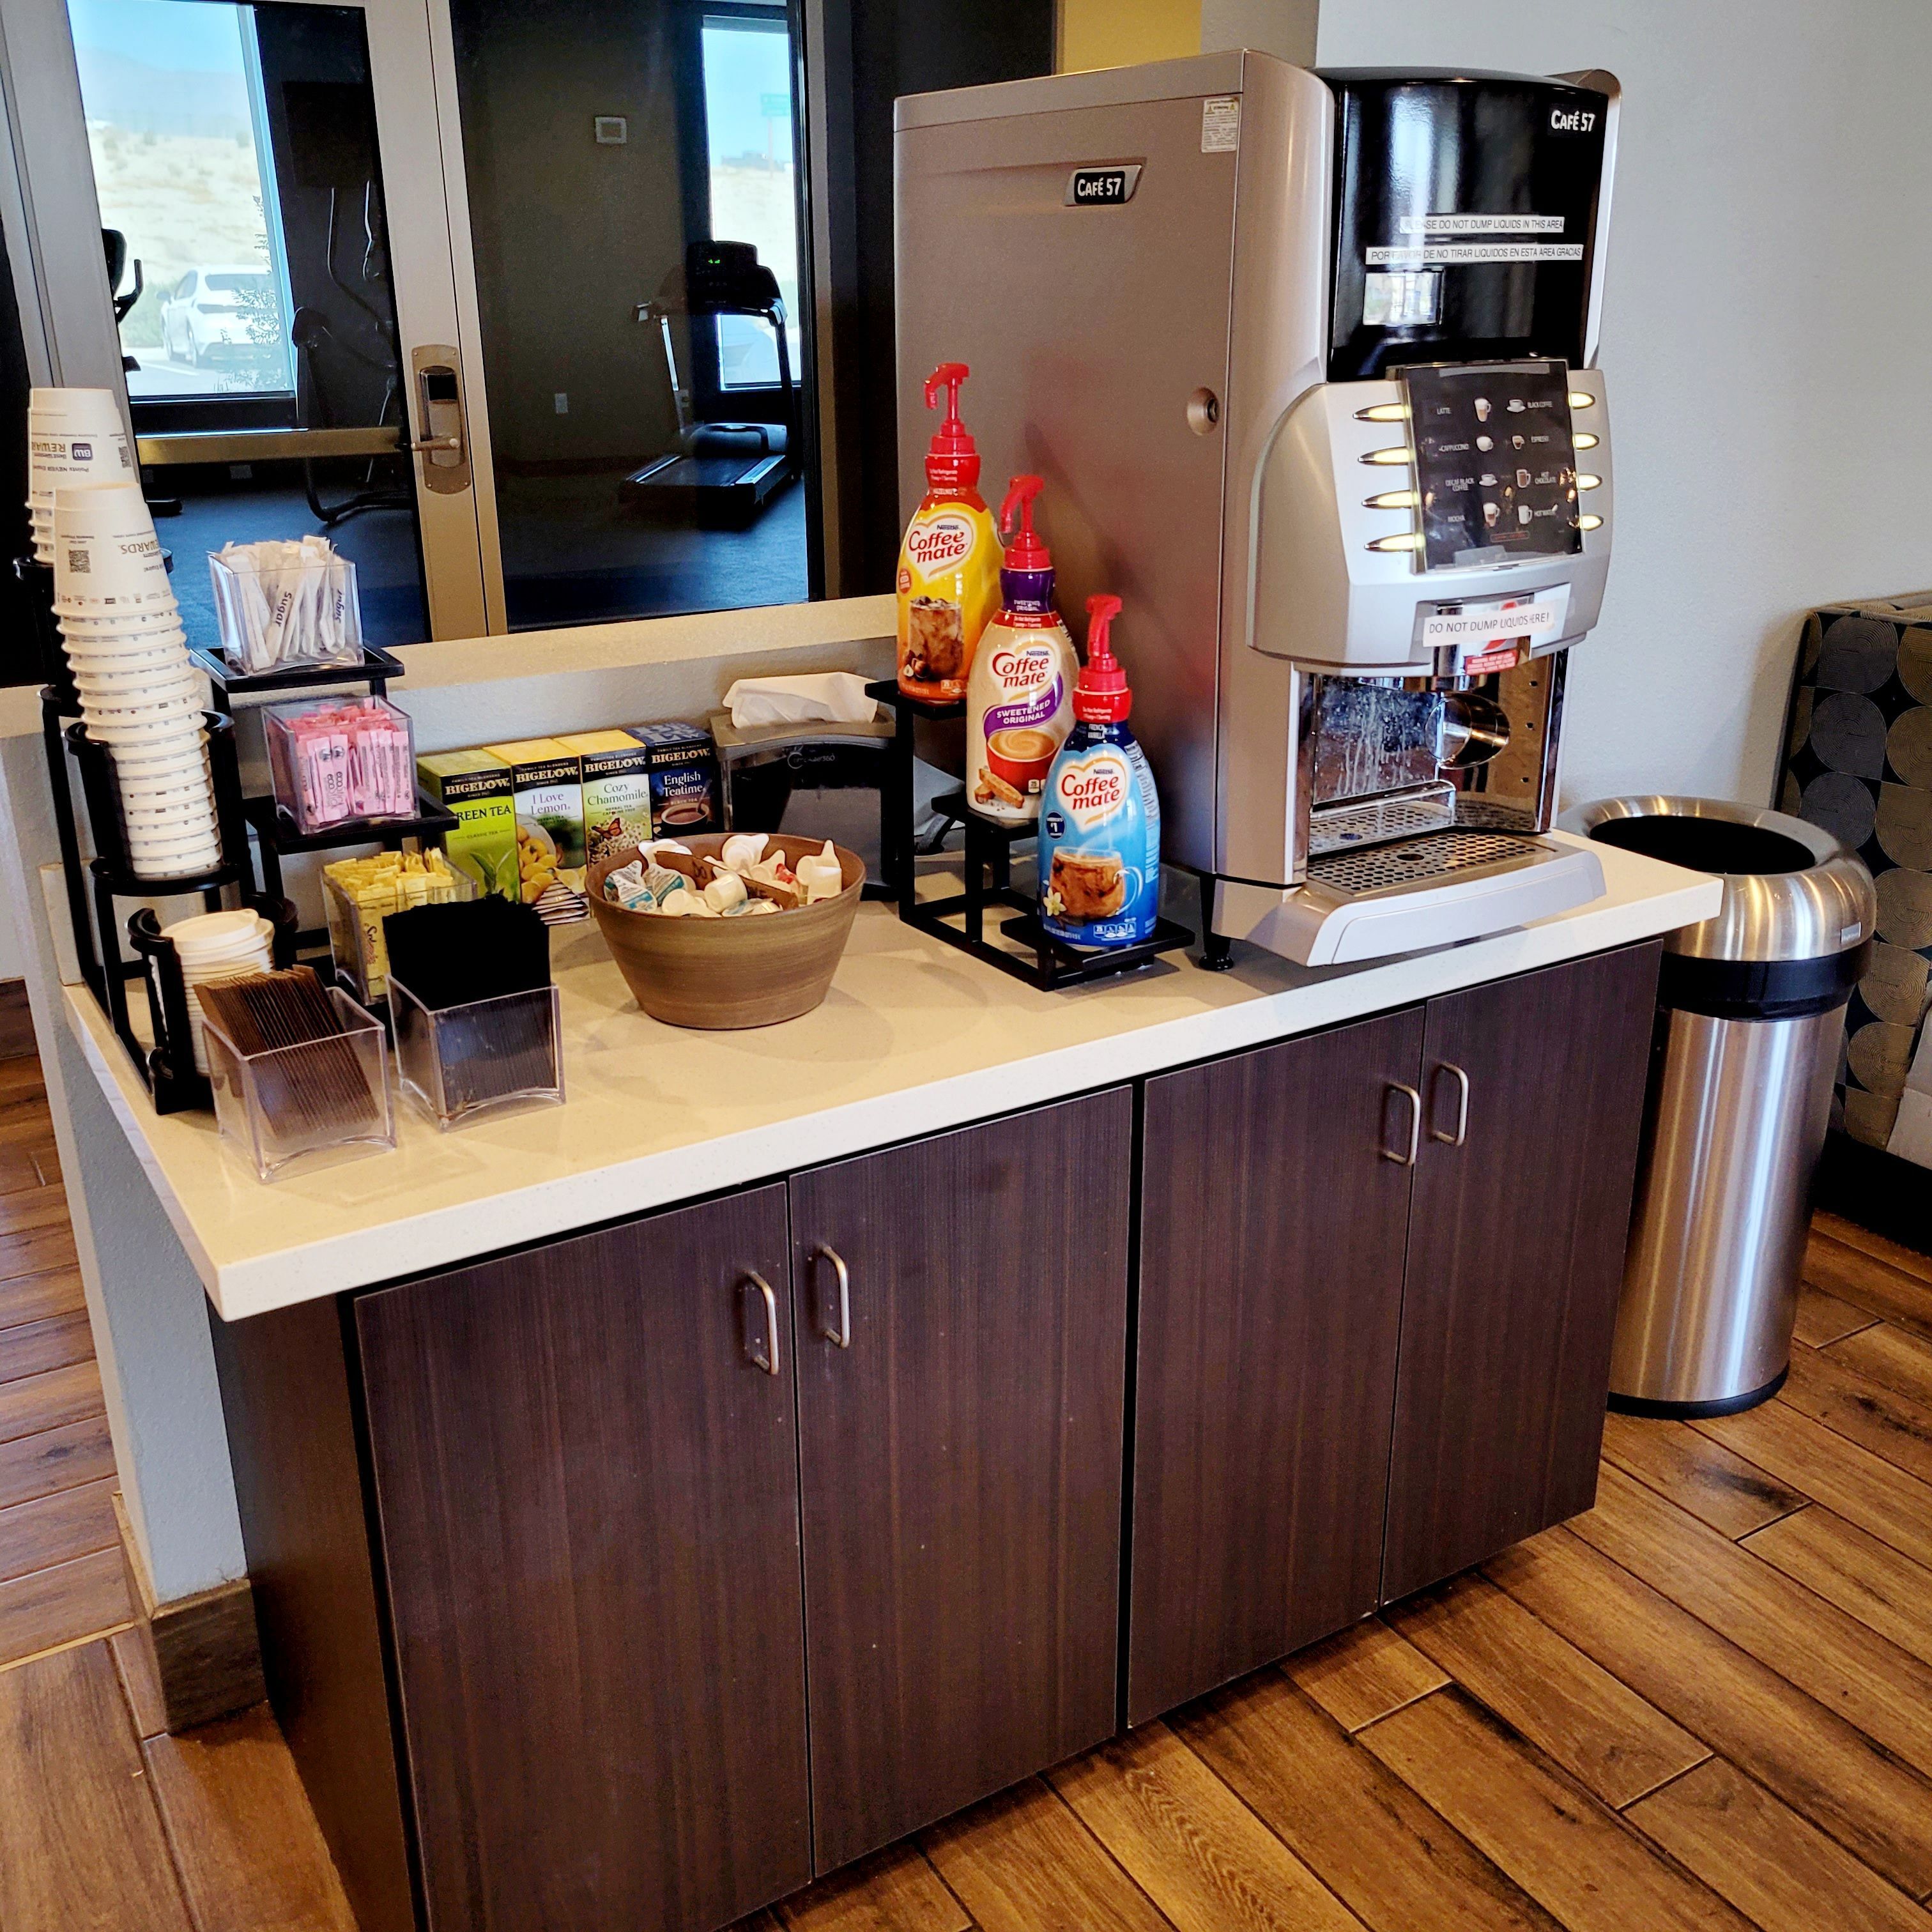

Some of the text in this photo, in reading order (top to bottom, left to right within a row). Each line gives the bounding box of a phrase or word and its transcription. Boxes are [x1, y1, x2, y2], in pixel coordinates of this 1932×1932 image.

[1581, 112, 1595, 132] 57
[1106, 178, 1122, 195] 57
[1405, 220, 1563, 229] LESE DO NOT DUMP LIQUIDS IN THIS AREA
[1371, 251, 1390, 260] POR
[1423, 250, 1435, 259] DE
[1437, 249, 1448, 258] NO
[1450, 249, 1473, 257] TIRAR
[1475, 248, 1508, 257] LIQUIDOS
[1510, 248, 1519, 256] EN
[1521, 247, 1537, 256] ESTA
[1539, 247, 1555, 256] AREA
[1556, 247, 1581, 256] GRACIAS
[73, 449, 91, 457] BW
[908, 530, 965, 551] Coffee
[917, 543, 965, 564] mate
[275, 592, 292, 627] Sugar
[1429, 623, 1443, 633] DO
[1446, 622, 1468, 632] NOT
[1469, 619, 1498, 631] DUMP
[1500, 615, 1528, 629] LIQUIDS
[992, 652, 1049, 677] Coffee
[1003, 671, 1045, 688] mate
[997, 699, 1051, 719] SWEETENED
[1003, 711, 1045, 724] ORIGINAL
[651, 748, 710, 763] BIGELOW
[585, 756, 645, 773] BIGELOW
[515, 767, 578, 783] BIGELOW
[664, 770, 701, 786] English
[445, 778, 509, 795] BIGELOW
[604, 783, 629, 793] Cozy
[664, 785, 703, 797] Teatime
[1061, 774, 1119, 797] Coffee
[533, 793, 564, 804] I Love
[587, 788, 646, 806] Chamomile
[1072, 788, 1120, 810] mate
[457, 805, 512, 821] REEN TEA
[531, 804, 567, 815] Lemon
